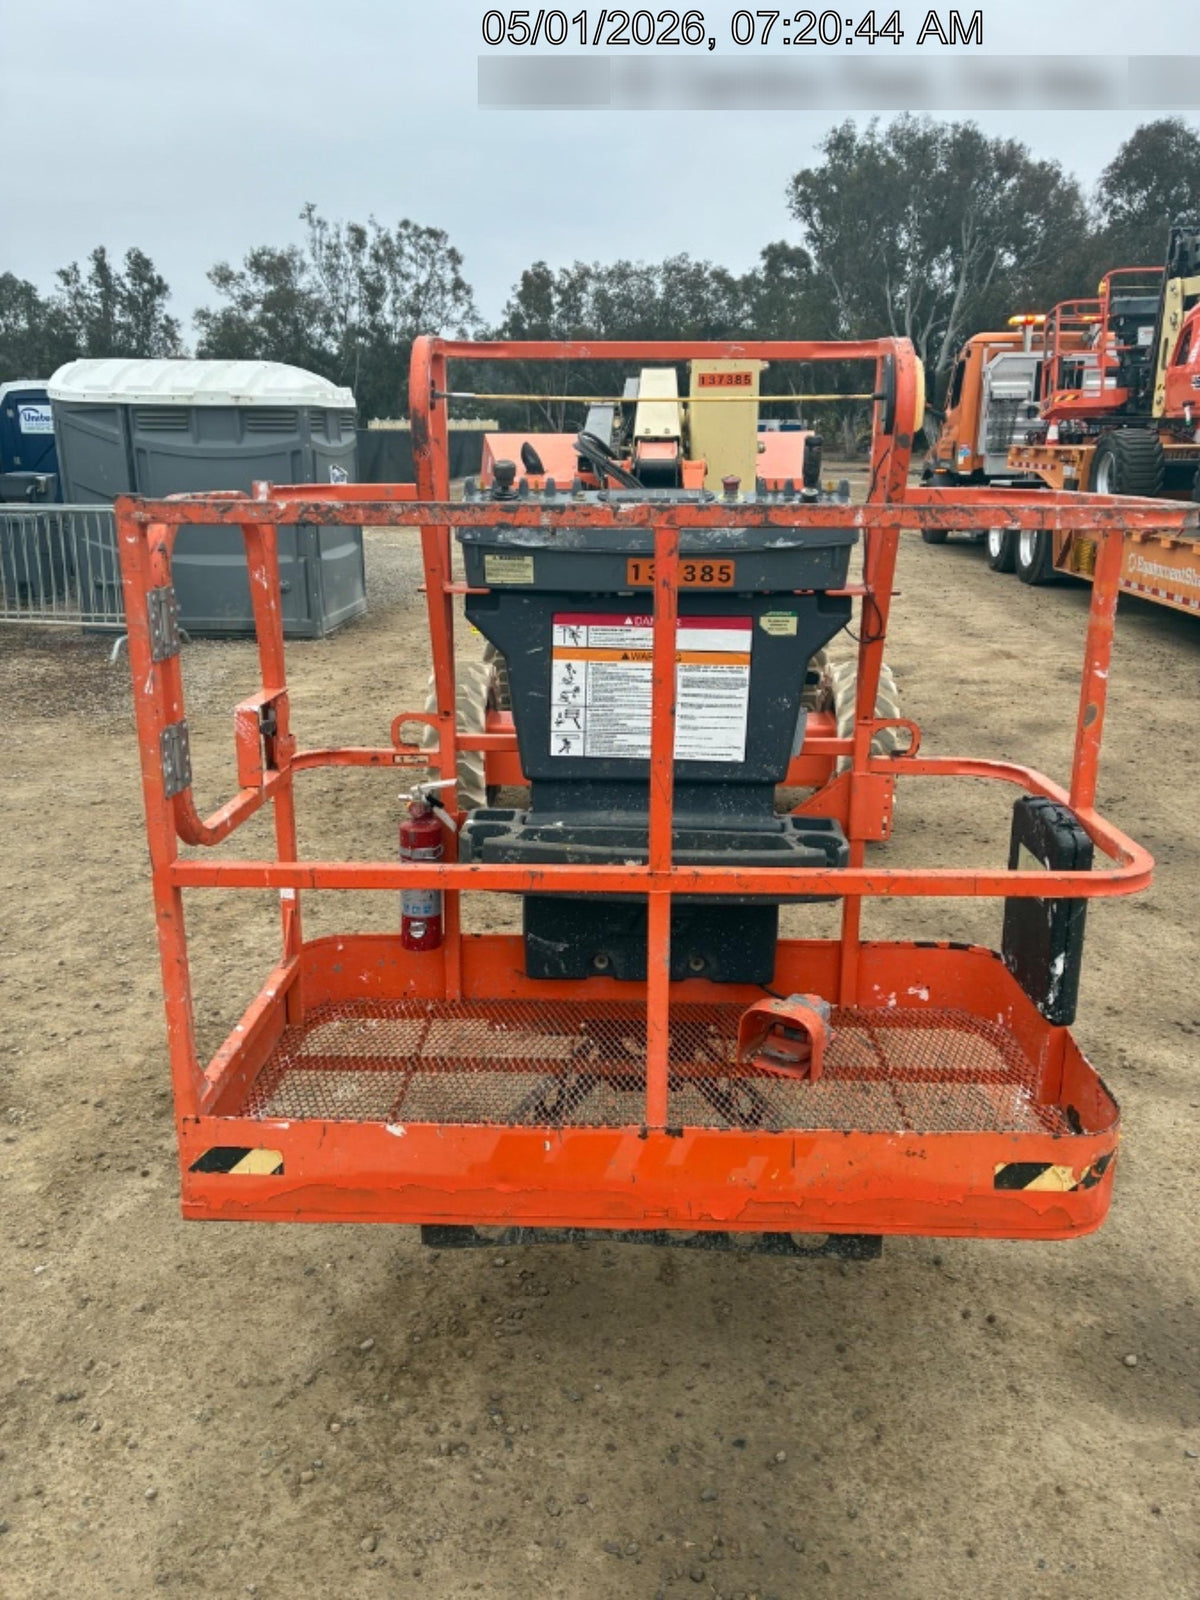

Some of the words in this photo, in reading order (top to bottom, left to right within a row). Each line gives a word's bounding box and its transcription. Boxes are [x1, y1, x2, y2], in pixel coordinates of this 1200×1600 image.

[701, 374, 751, 385] 137385
[631, 564, 732, 583] 13385
[634, 616, 682, 627] DANR
[631, 651, 682, 662] WARG
